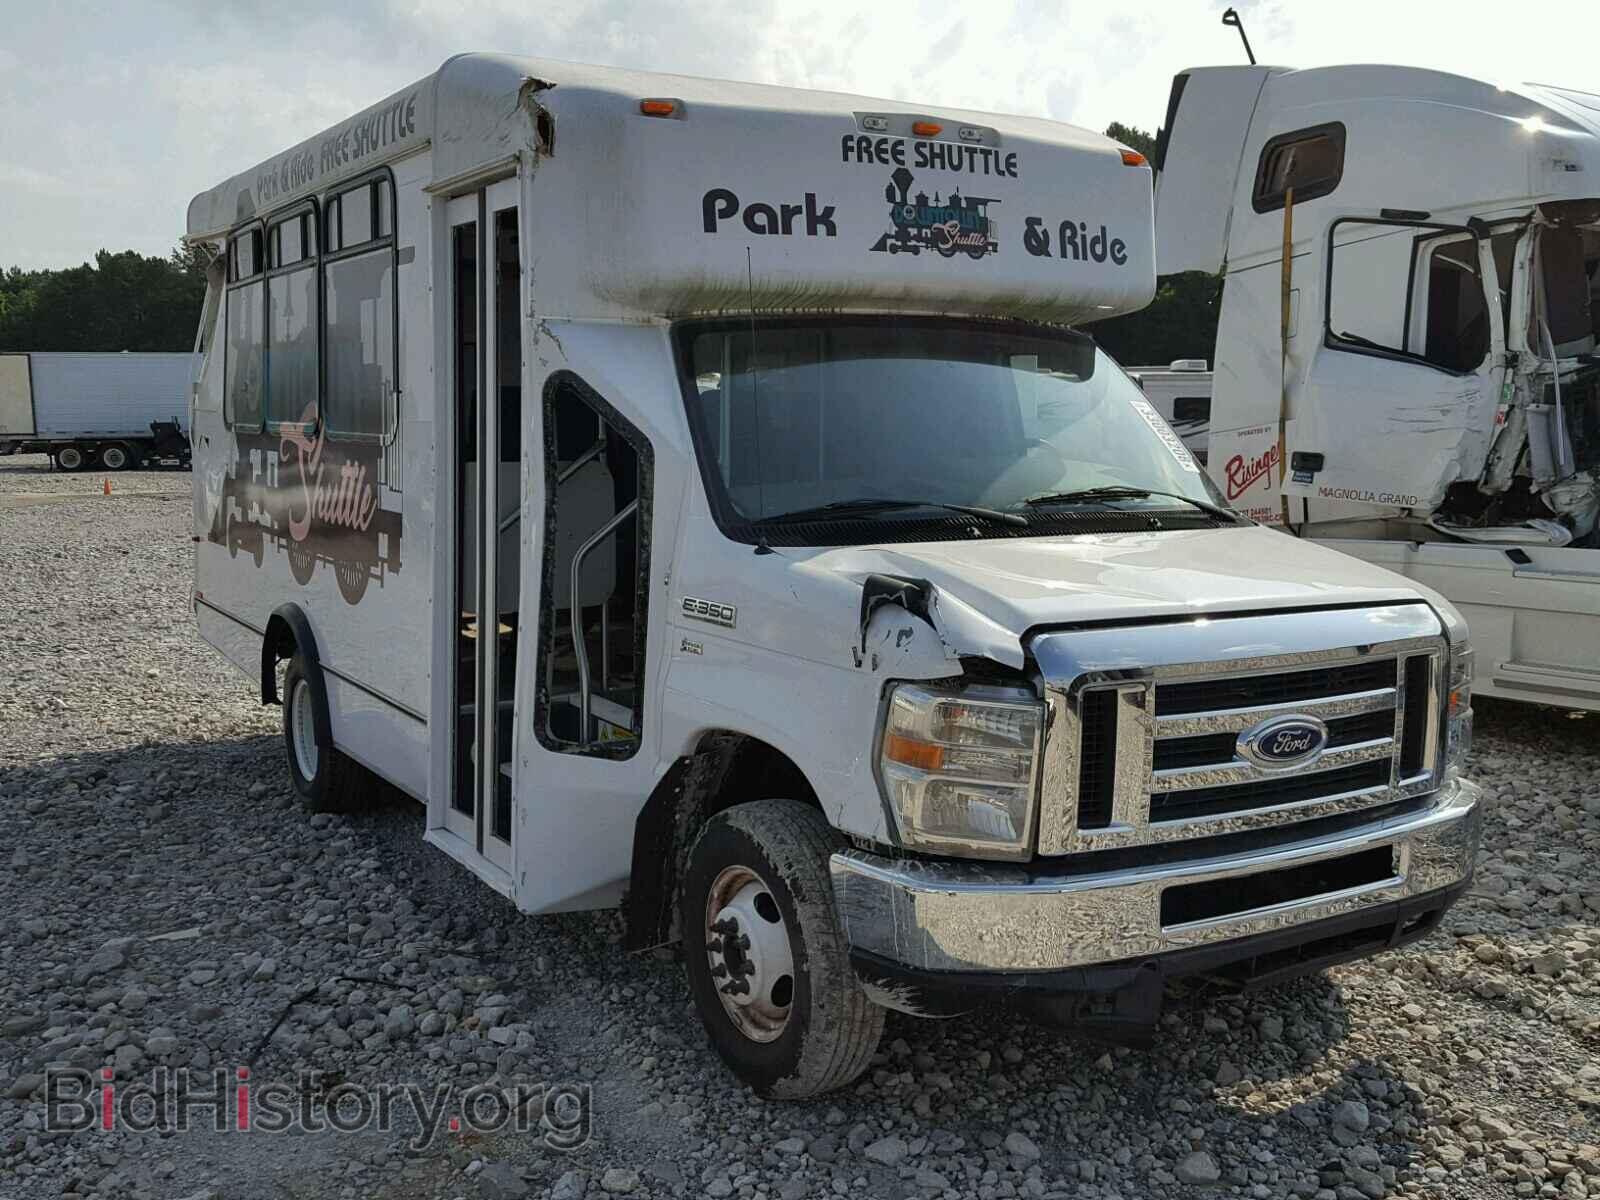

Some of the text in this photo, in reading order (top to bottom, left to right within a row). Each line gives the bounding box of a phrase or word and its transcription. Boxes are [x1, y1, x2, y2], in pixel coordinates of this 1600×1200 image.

[320, 130, 349, 174] FREE
[353, 93, 418, 160] SHUTTLE
[842, 134, 1018, 178] FREE SHUTTLE
[702, 188, 1128, 266] Park & Ride
[931, 220, 986, 249] Shuttle
[280, 400, 378, 542] Shuttle
[1318, 487, 1418, 506] MAGNOLIA GRAND
[1272, 730, 1312, 754] Ford
